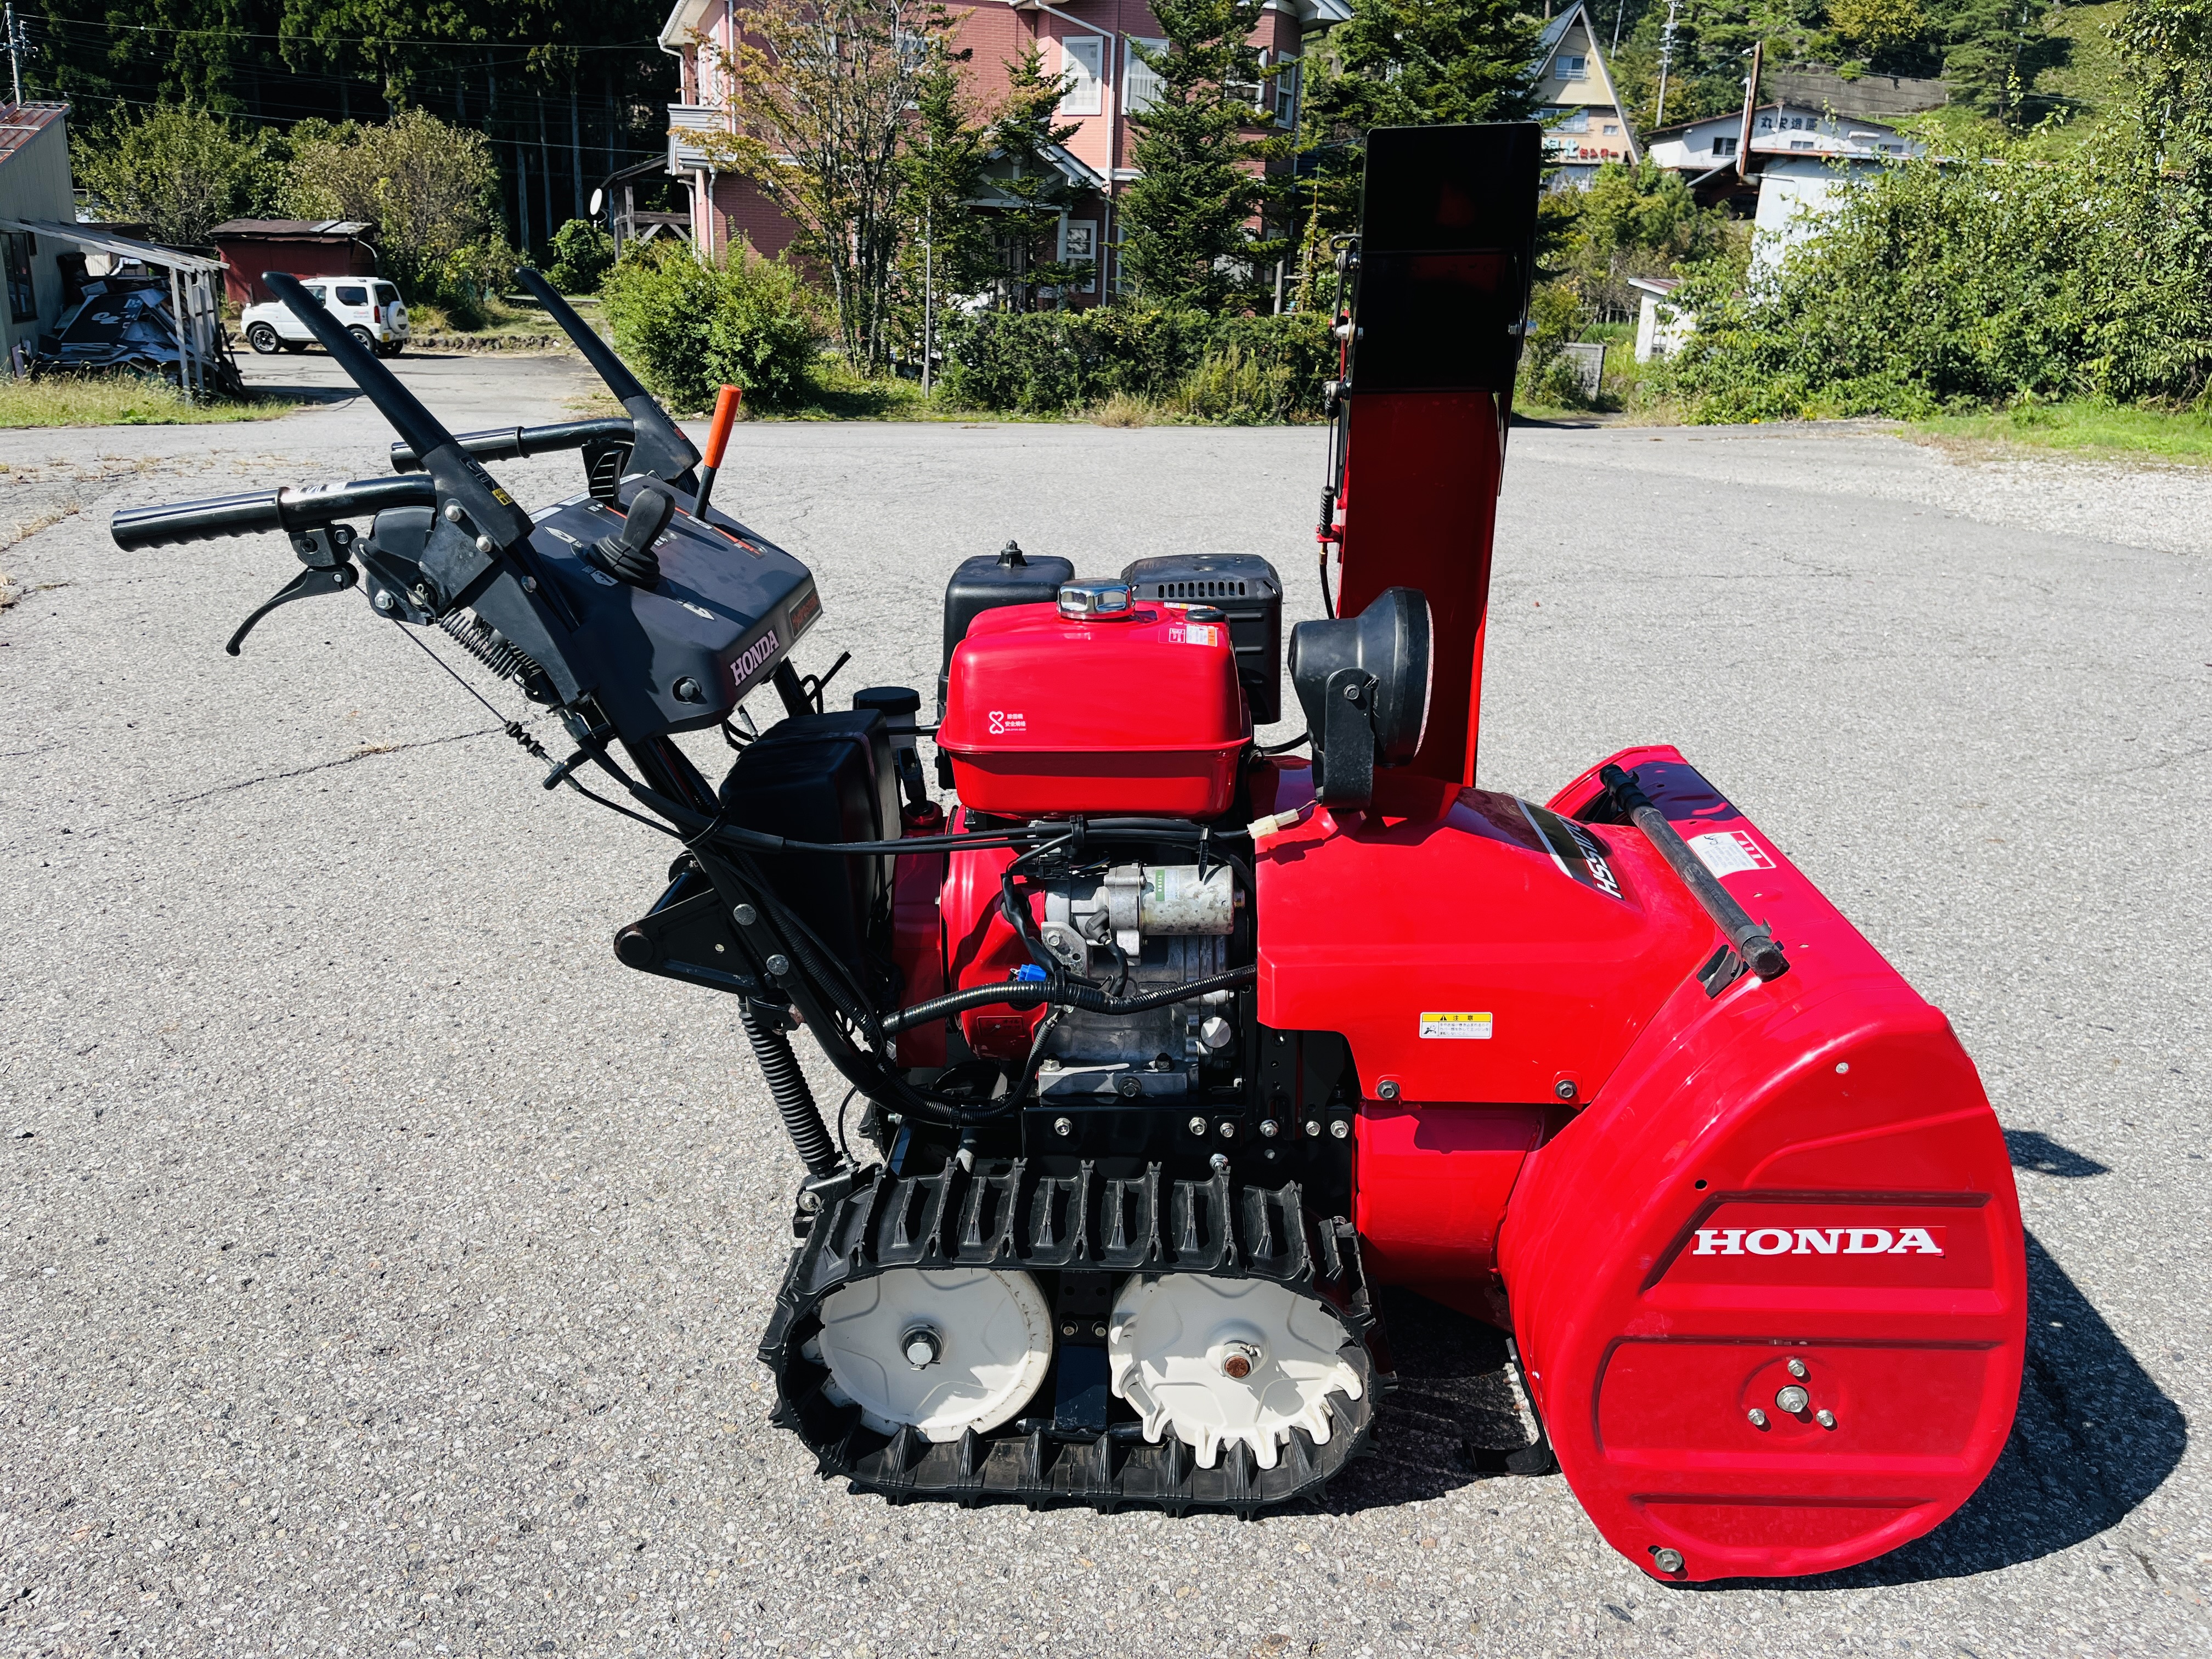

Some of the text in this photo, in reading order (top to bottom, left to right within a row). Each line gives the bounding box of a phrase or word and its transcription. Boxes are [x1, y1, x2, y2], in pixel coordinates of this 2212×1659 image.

[730, 630, 780, 686] HONDA
[1555, 815, 1622, 899] HSS1170
[1693, 1228, 1942, 1255] HONDA
